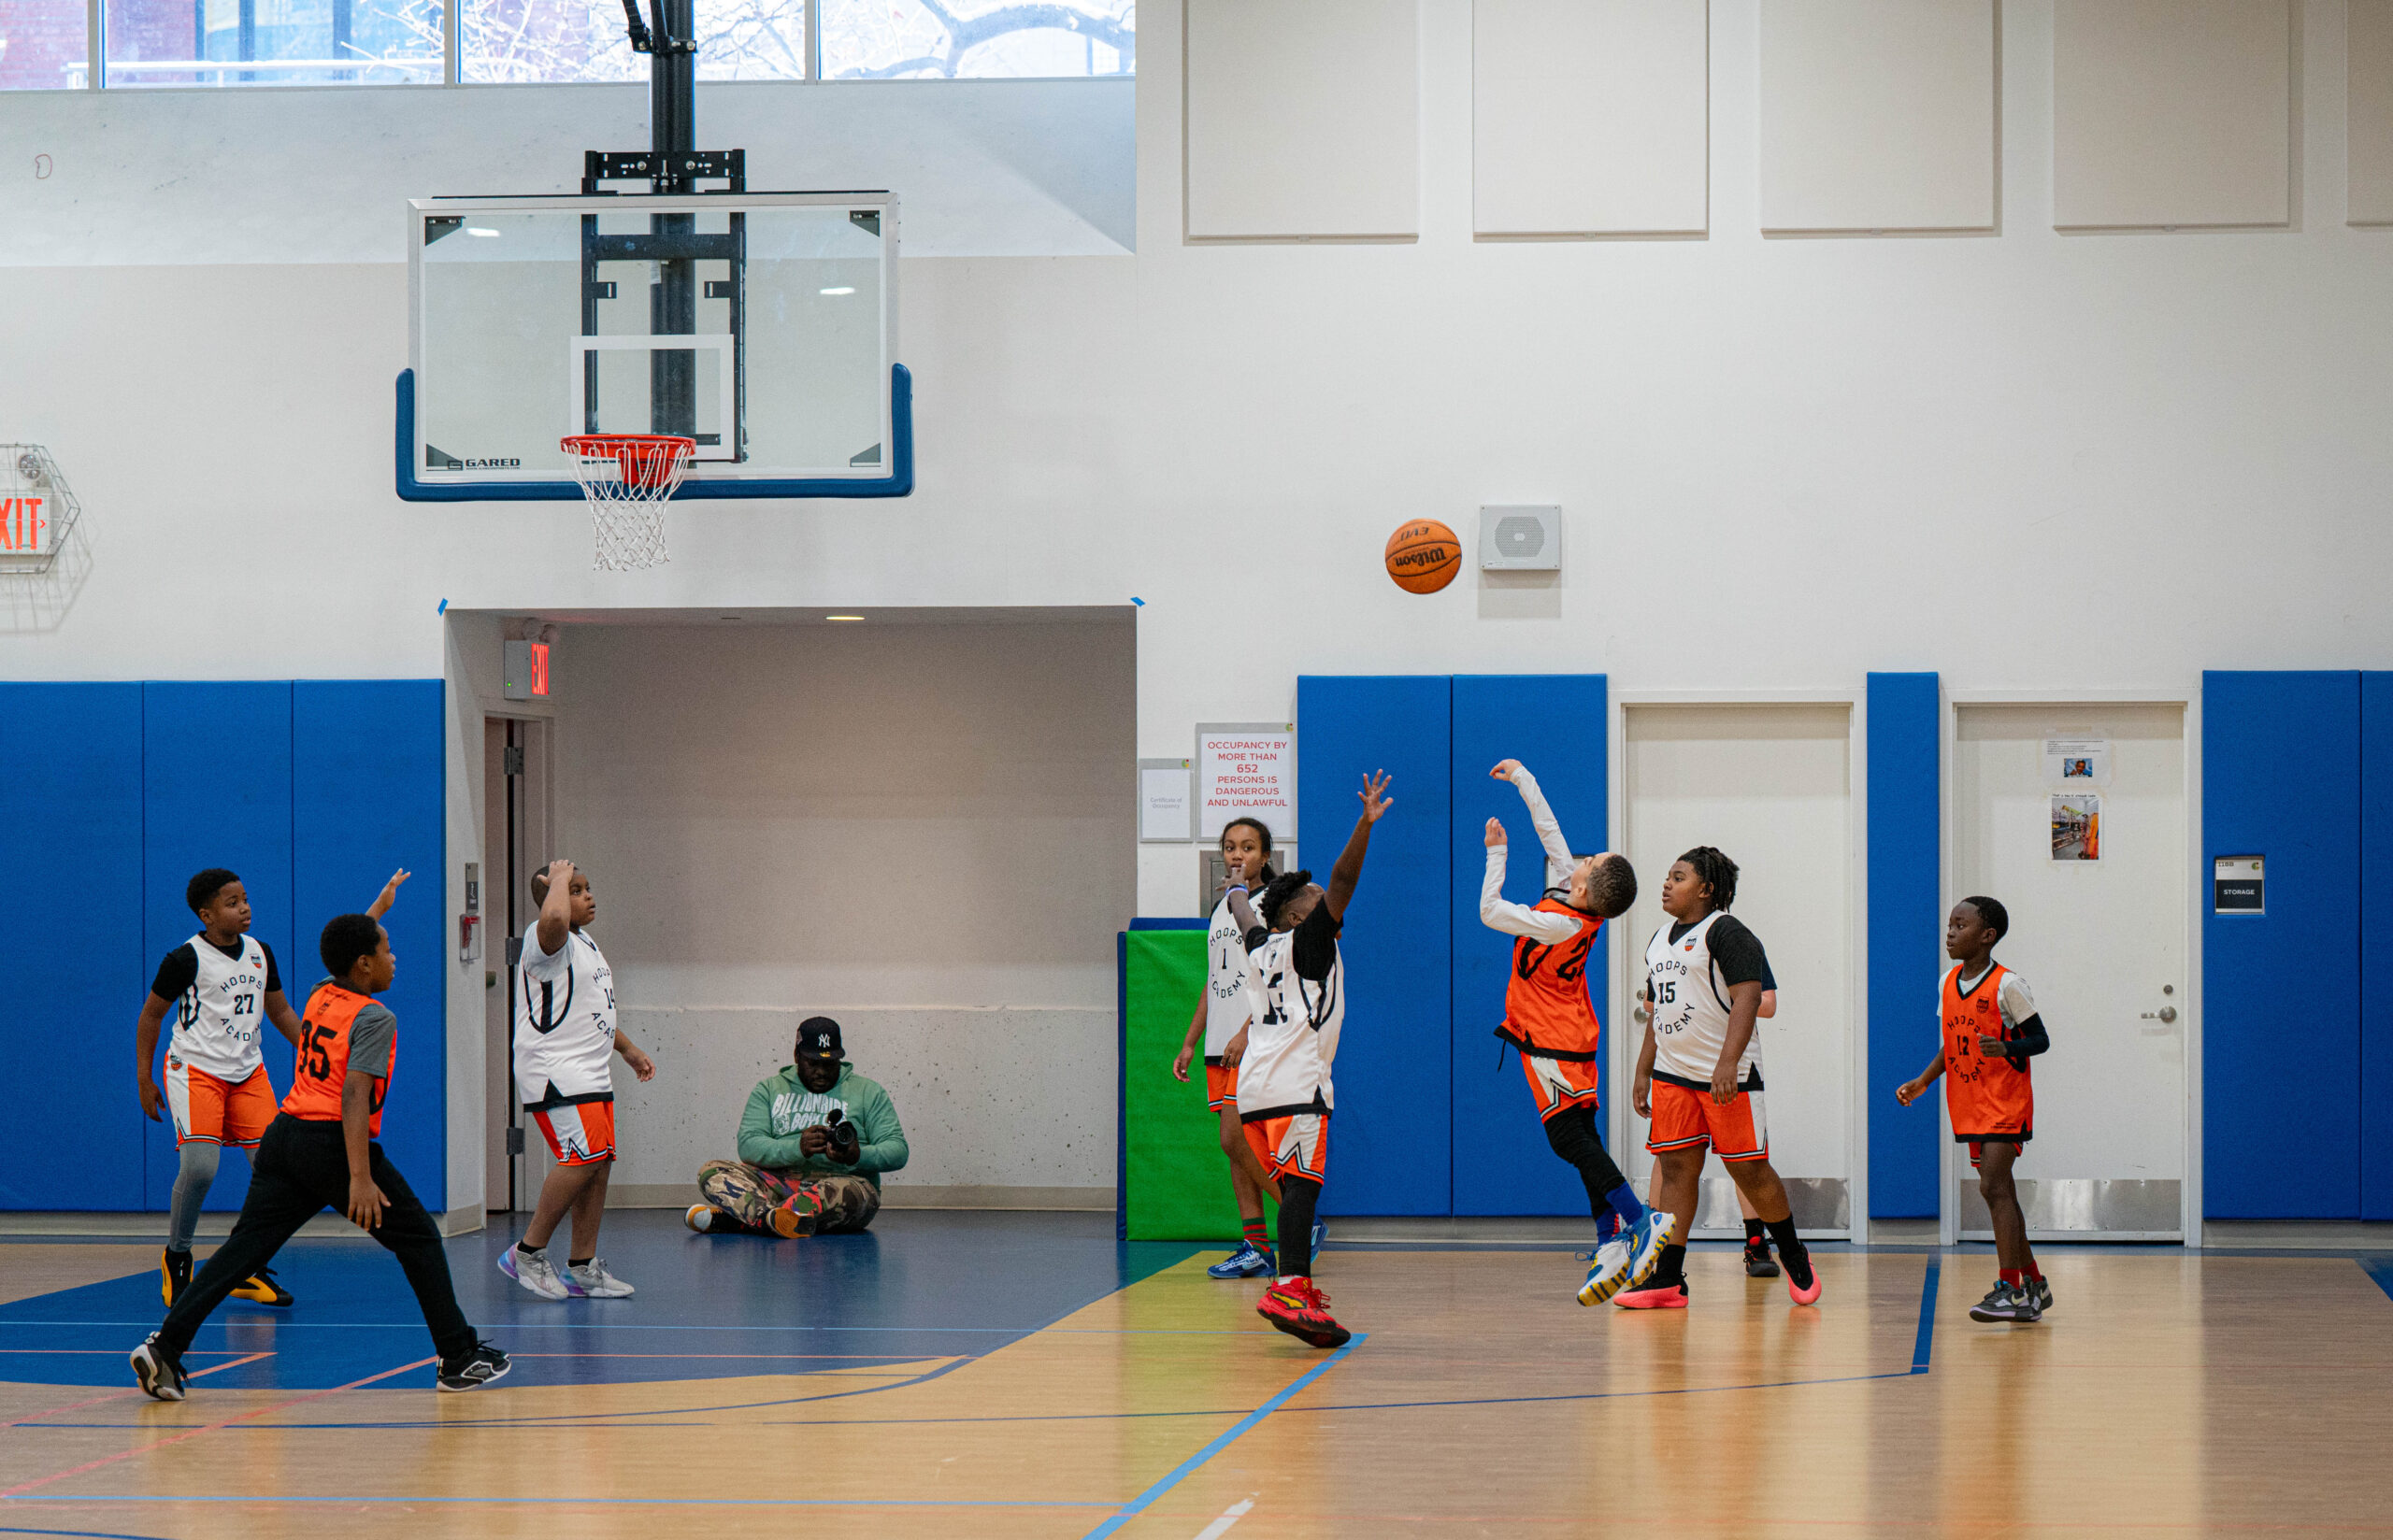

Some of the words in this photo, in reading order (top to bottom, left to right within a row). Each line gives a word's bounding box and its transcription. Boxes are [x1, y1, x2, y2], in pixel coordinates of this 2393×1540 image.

[466, 458, 521, 467] GARED
[0, 498, 43, 550] XIT
[1396, 547, 1446, 567] Wilson
[531, 643, 550, 695] EXIT
[1207, 741, 1271, 749] OCCUPANCY
[1273, 741, 1287, 749] BY
[1236, 763, 1258, 774] 652
[1217, 776, 1265, 784] PERSONS
[1267, 776, 1278, 784] IS
[1215, 787, 1280, 795] DANGEROUS
[1210, 927, 1243, 947] HOOPS
[1222, 948, 1227, 970] 1
[220, 974, 262, 993] HOOPS
[1658, 980, 1676, 1005] 15
[234, 993, 254, 1016] 27
[818, 1033, 830, 1048] NY
[1956, 1034, 1970, 1056] 12
